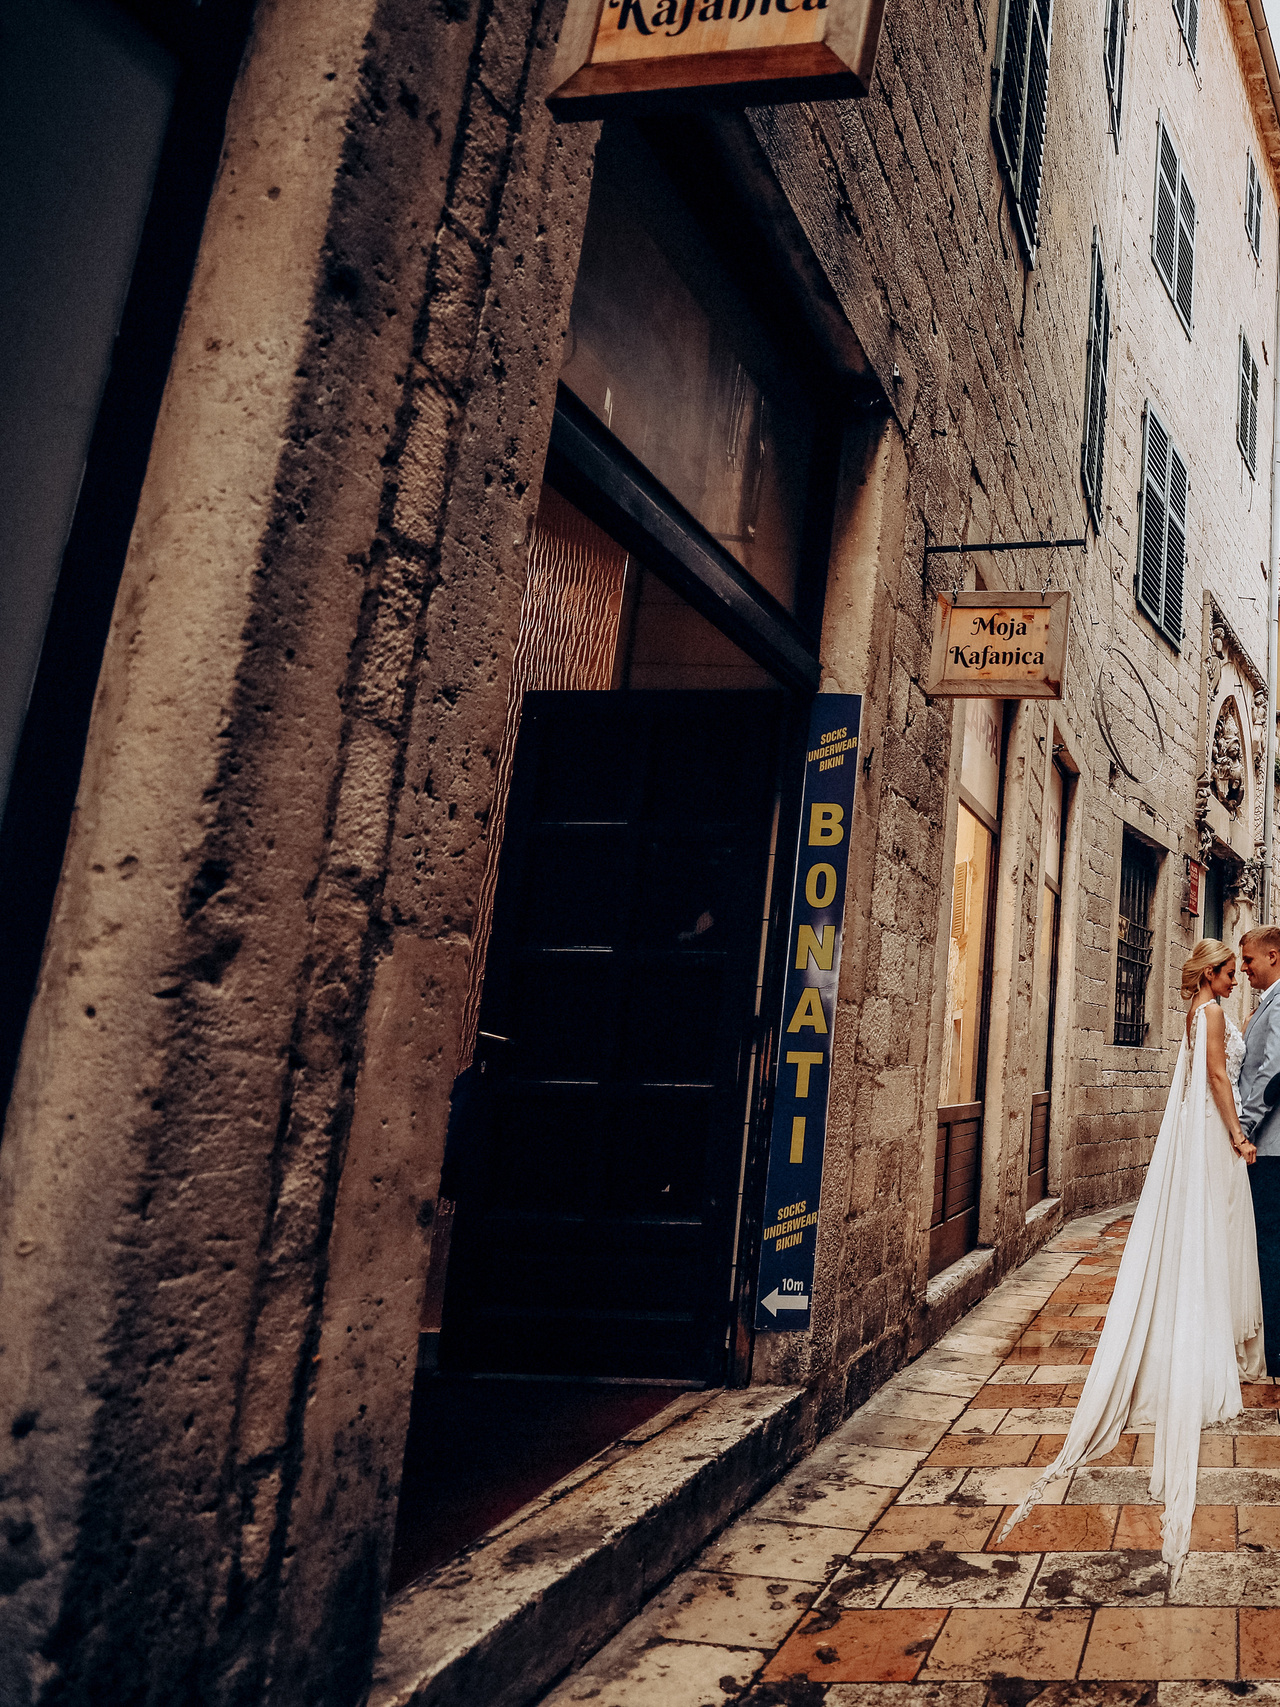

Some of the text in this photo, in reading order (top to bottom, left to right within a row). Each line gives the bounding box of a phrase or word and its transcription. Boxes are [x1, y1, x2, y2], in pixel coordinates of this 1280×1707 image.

[970, 612, 1027, 641] Moja
[949, 645, 1045, 670] Kafanica
[820, 726, 848, 745] SOCKS
[808, 736, 858, 762] UNDERWEAR
[819, 753, 845, 772] BIKINI
[785, 802, 845, 1164] BONATI
[777, 1200, 807, 1221] SOCKS
[763, 1211, 818, 1241] UNDERWEAR
[775, 1231, 803, 1252] BIKINI
[782, 1277, 804, 1292] 10m
